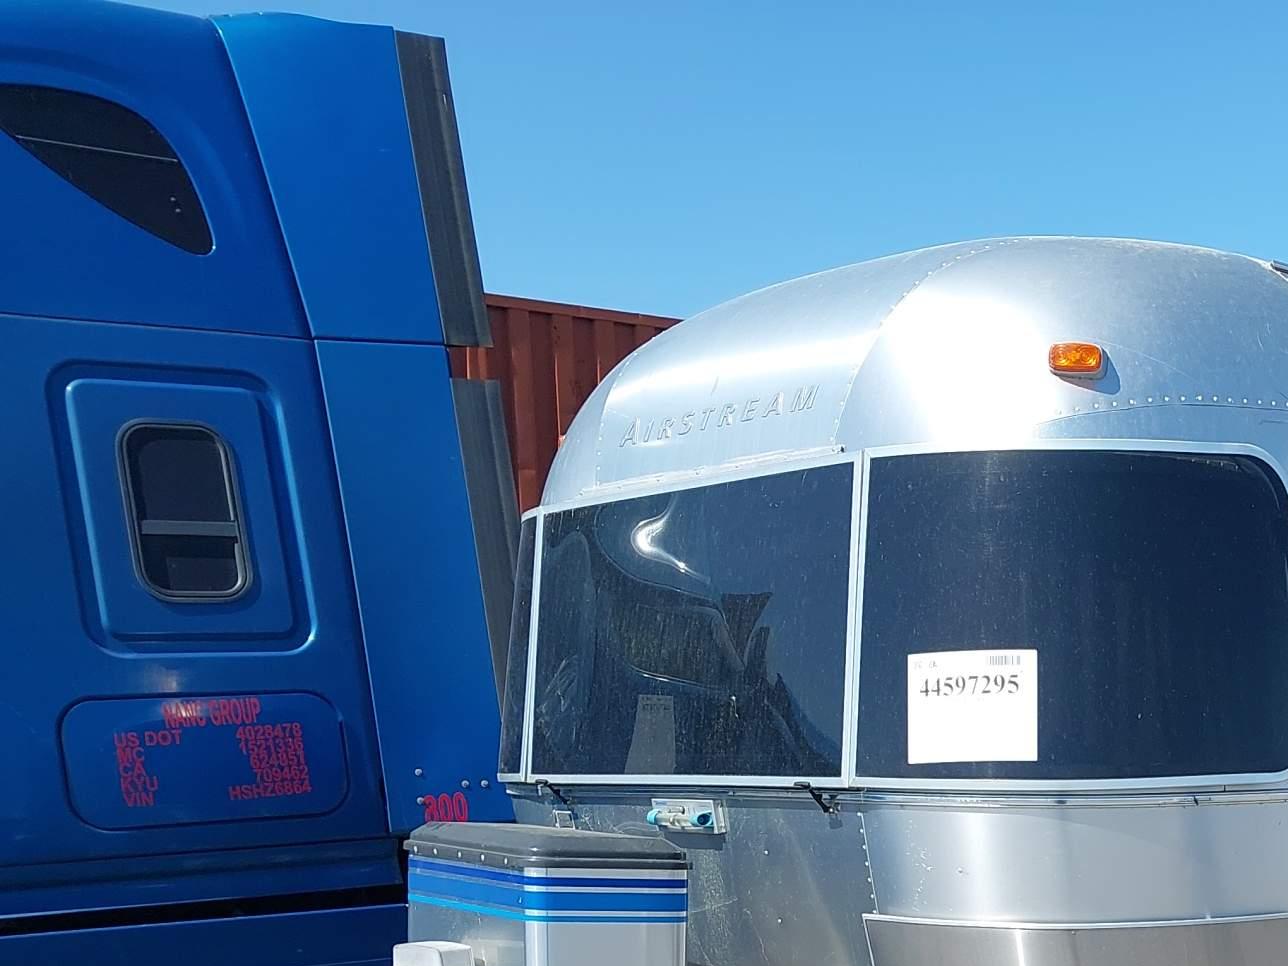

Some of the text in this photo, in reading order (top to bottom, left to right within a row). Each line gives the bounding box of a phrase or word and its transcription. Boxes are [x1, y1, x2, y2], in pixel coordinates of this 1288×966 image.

[619, 383, 820, 448] AIRSTREAM
[919, 674, 1020, 697] 44597295
[208, 696, 261, 726] GROUP
[113, 731, 140, 747] US
[144, 729, 182, 746] DOT
[117, 746, 145, 763] MC
[119, 760, 147, 777] CA
[121, 774, 159, 793] KYU
[123, 791, 155, 808] VIN
